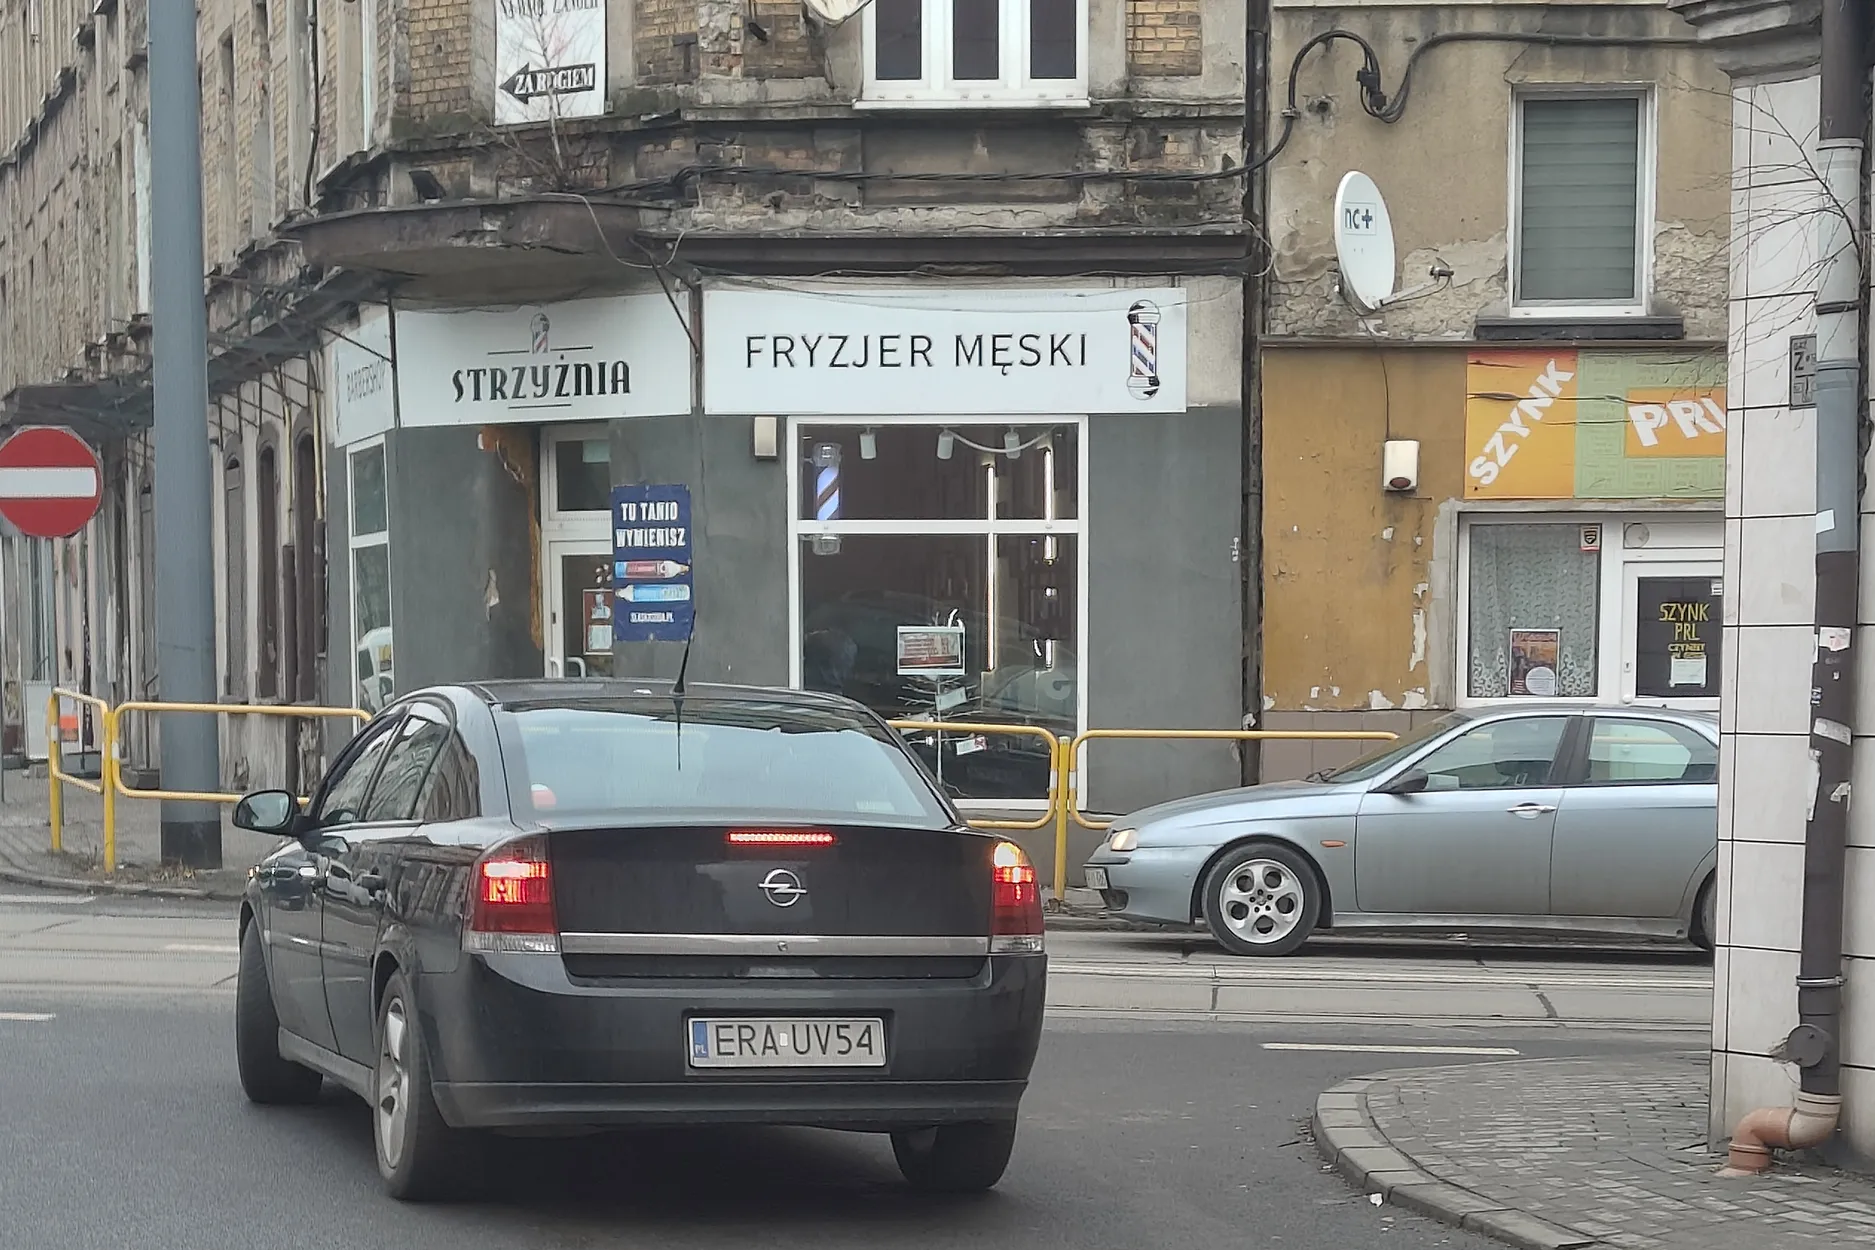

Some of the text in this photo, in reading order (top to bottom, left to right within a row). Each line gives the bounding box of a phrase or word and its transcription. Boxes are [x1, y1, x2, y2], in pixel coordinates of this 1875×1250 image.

[514, 73, 534, 94] ZA
[745, 333, 1087, 376] FRYZJER MĘSKI
[452, 354, 630, 403] STRZYŻNIA
[1469, 359, 1575, 485] SZYNK
[621, 502, 678, 522] TU TANIO
[616, 528, 686, 548] WYMIENISZ
[1659, 602, 1710, 621] SZYNK
[1675, 622, 1700, 641] PRL
[715, 1024, 874, 1057] ERA UV54
